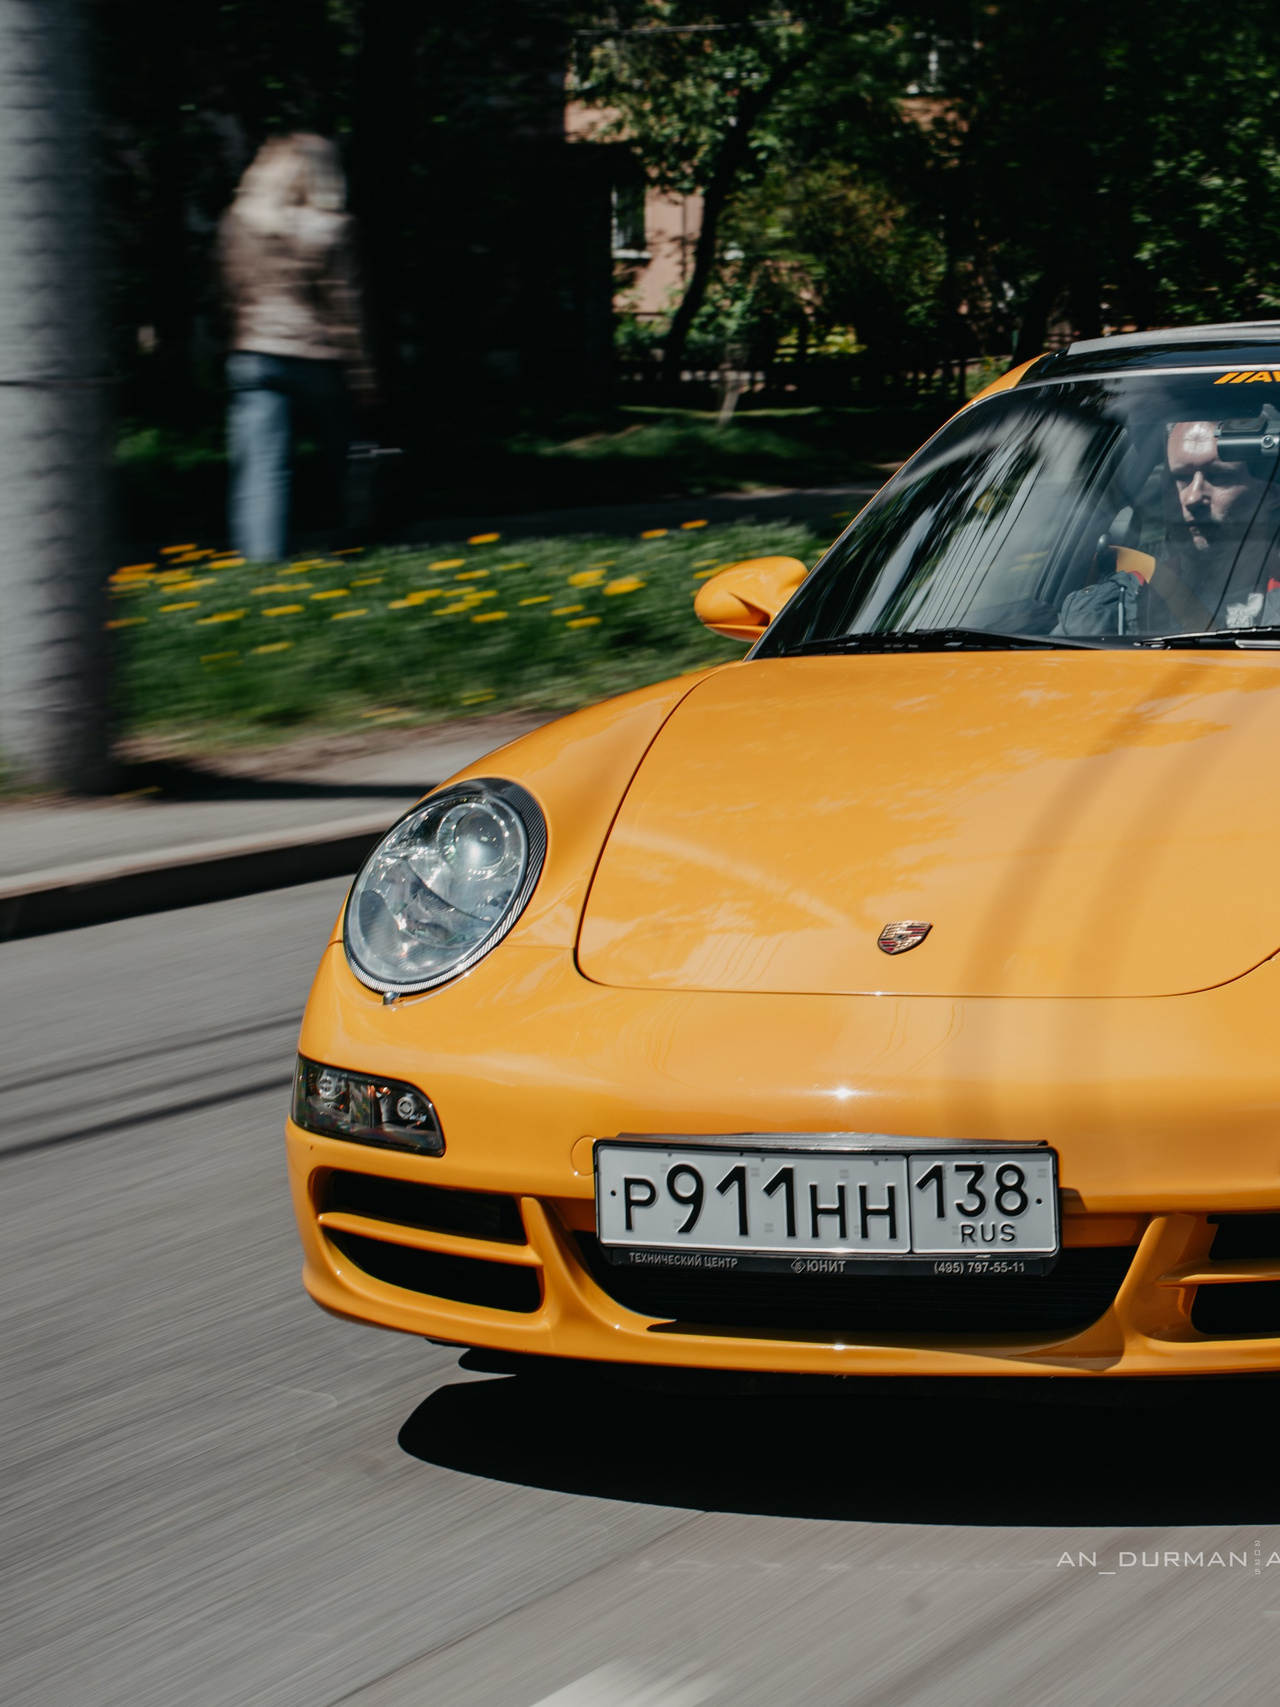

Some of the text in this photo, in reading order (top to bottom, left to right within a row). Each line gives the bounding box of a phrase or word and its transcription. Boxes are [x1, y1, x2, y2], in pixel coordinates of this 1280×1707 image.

[915, 1163, 1028, 1219] 138
[960, 1223, 1017, 1244] RUS
[628, 1251, 739, 1269] ТЕХНИЧЕСКИЙ ЦЕНТР
[806, 1259, 847, 1274] ЮНИТ
[933, 1261, 1026, 1275] (495) 797-55-11
